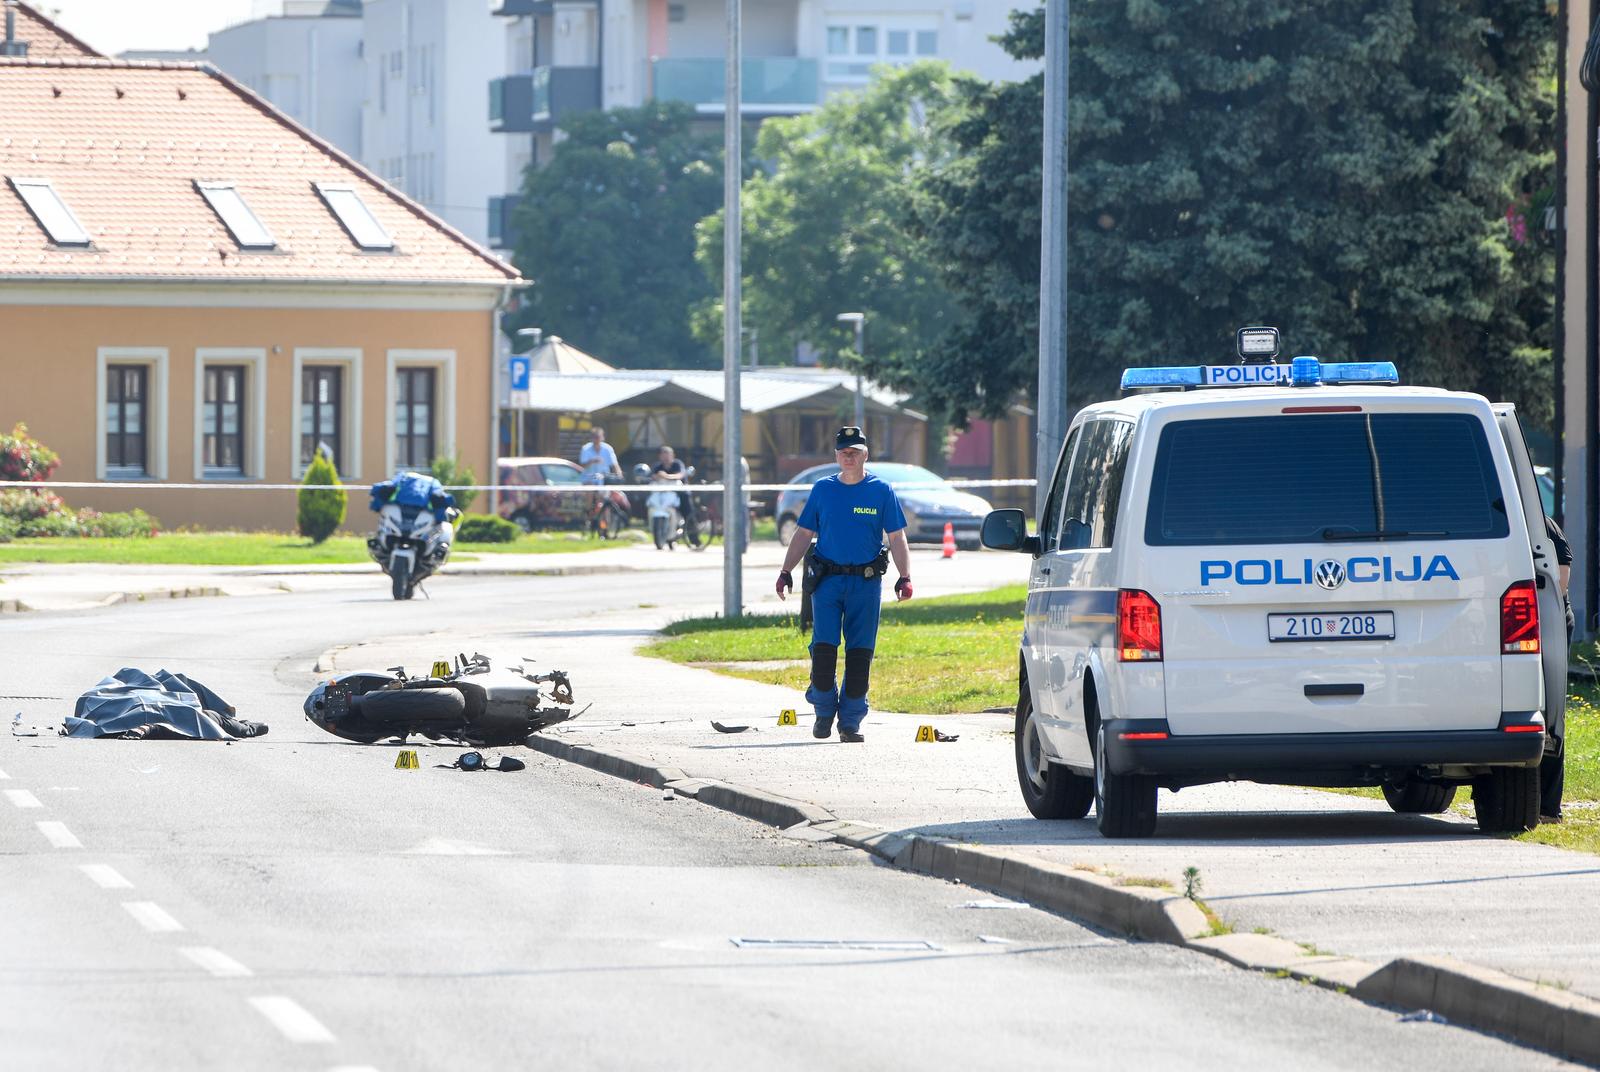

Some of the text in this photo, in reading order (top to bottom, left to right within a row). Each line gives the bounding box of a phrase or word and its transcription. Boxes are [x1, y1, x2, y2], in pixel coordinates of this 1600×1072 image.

[512, 361, 525, 385] P
[1212, 366, 1293, 383] POLICIJ
[853, 507, 877, 515] POLICIJA
[1286, 616, 1376, 635] 210 208
[434, 663, 446, 676] 11
[922, 727, 929, 741] 9
[399, 751, 408, 767] 10
